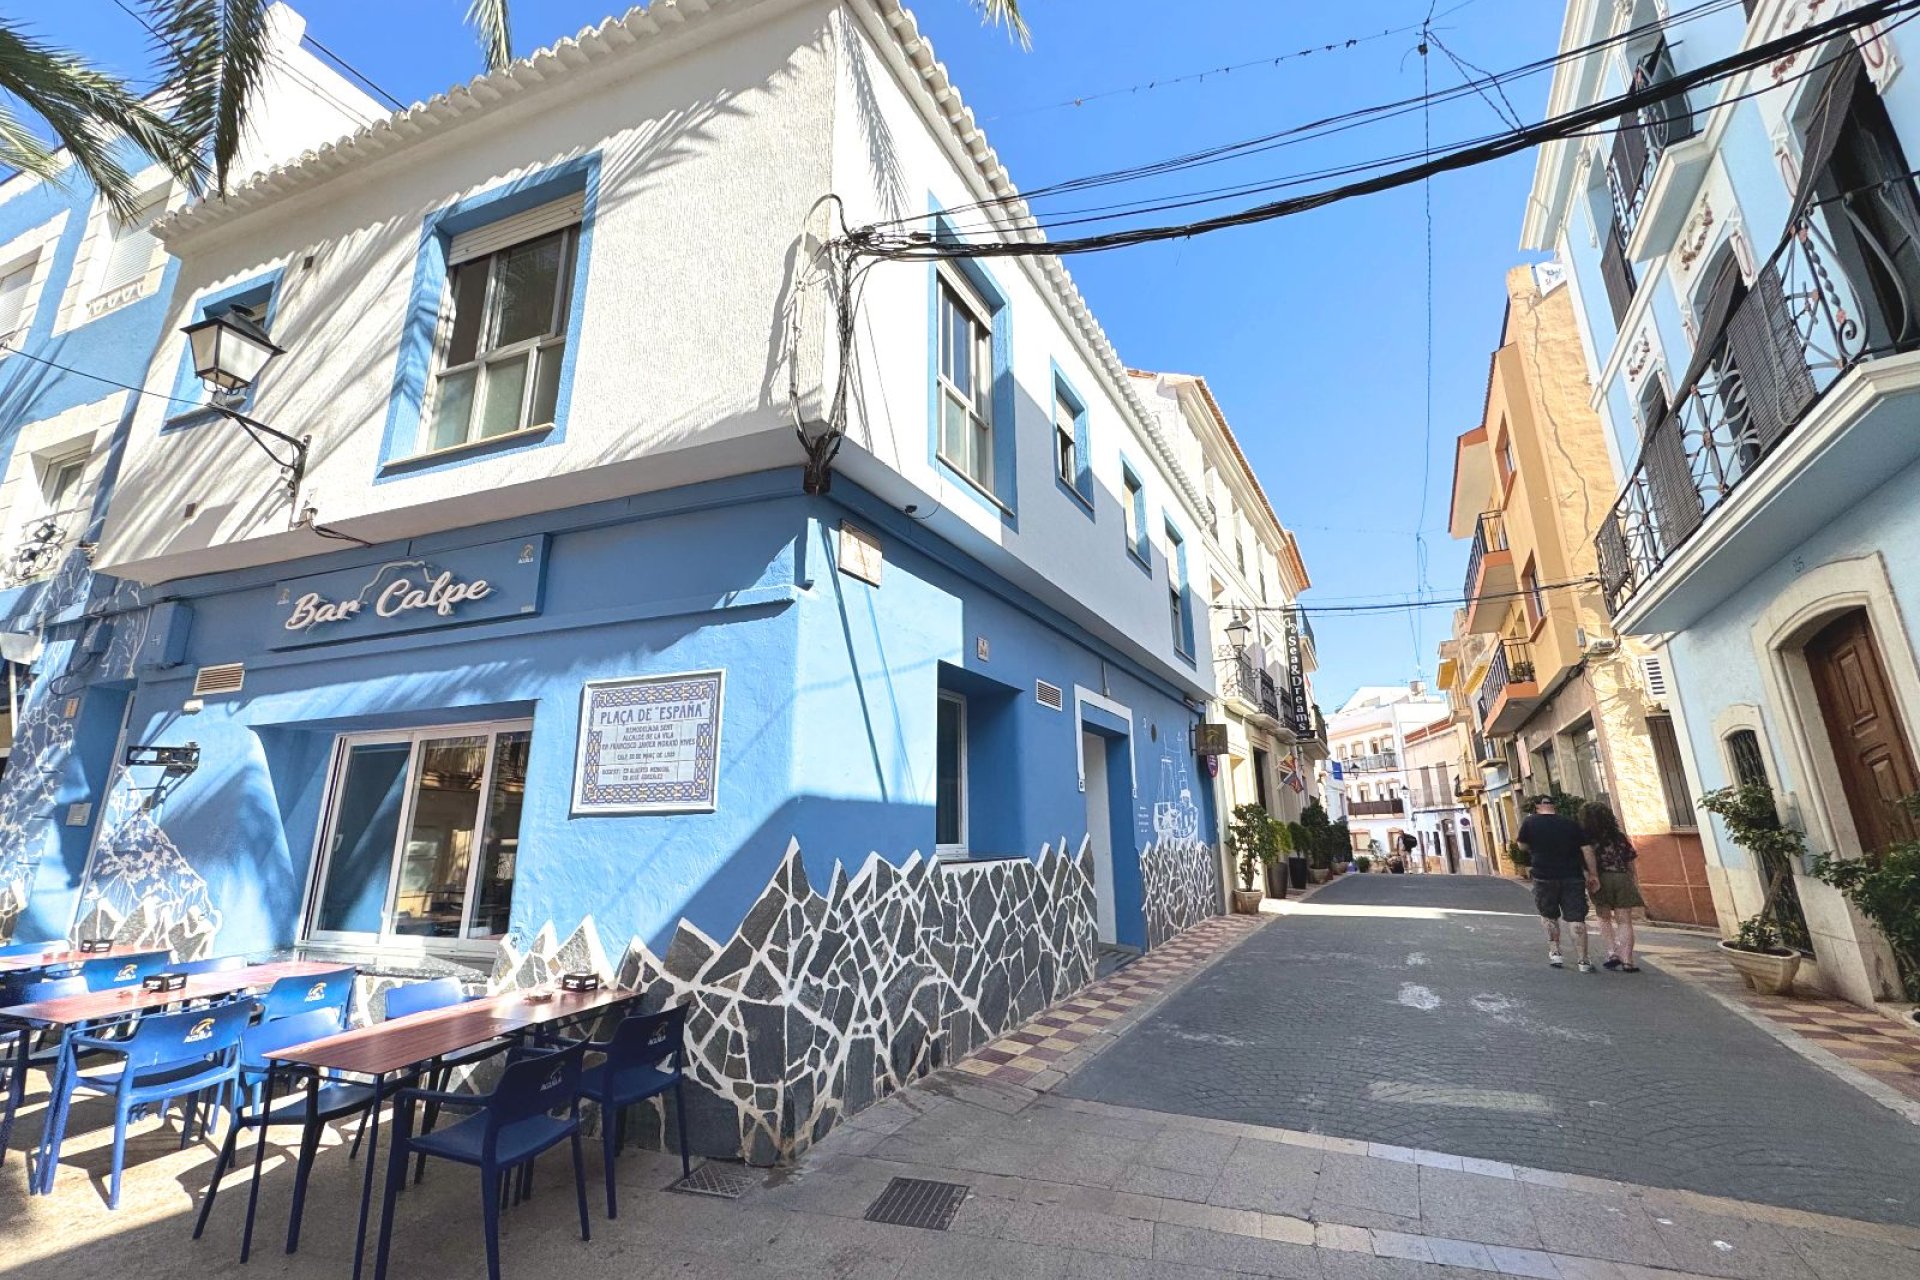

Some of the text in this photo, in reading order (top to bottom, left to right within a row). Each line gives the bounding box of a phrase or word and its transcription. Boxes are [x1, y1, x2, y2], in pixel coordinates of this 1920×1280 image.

[285, 571, 492, 630] Bar Calpe
[600, 708, 634, 726] PLAÇA
[638, 708, 652, 721] DE
